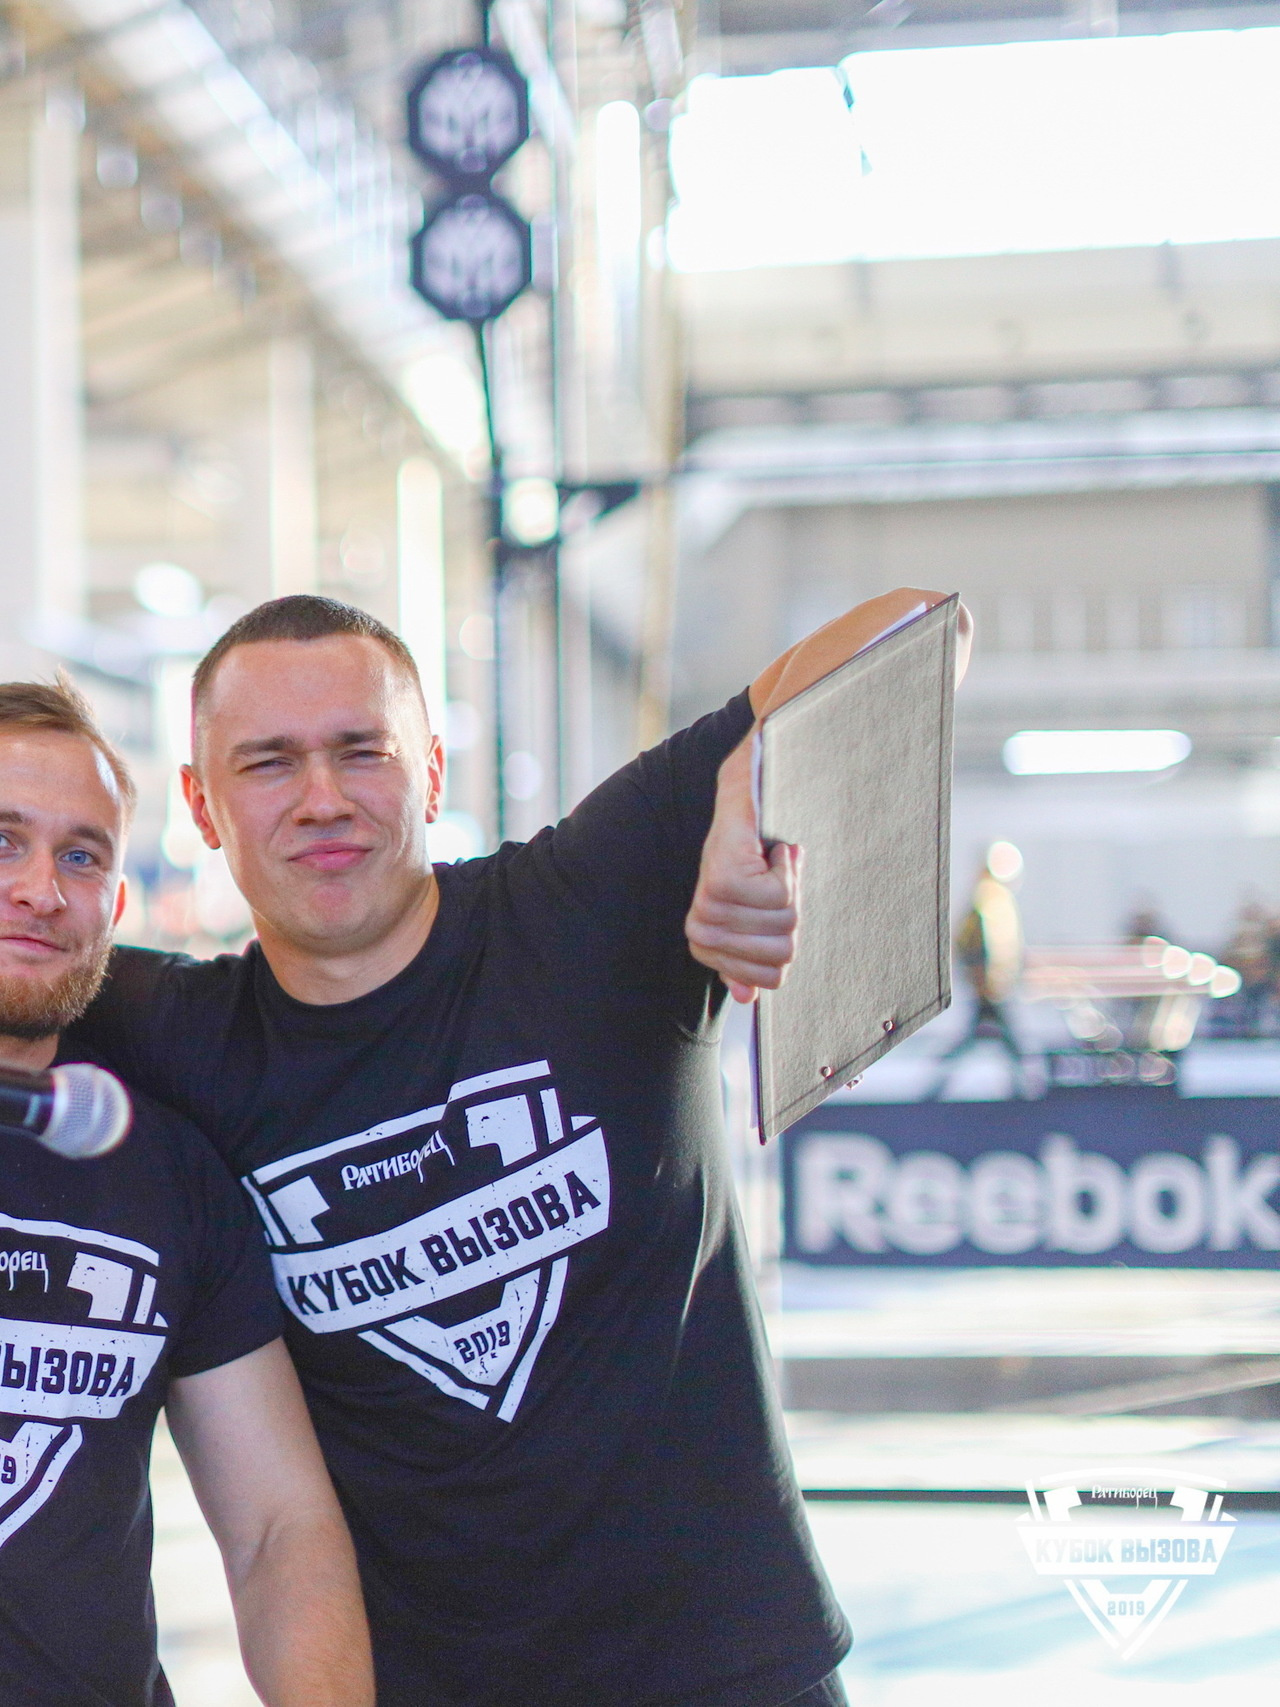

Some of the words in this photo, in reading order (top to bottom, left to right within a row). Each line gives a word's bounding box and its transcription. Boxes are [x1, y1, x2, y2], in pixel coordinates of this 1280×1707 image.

[286, 1246, 425, 1316] КУБОК
[420, 1170, 601, 1276] ВЫЗОВА
[793, 1131, 1280, 1256] Reebok
[453, 1320, 512, 1365] 2019
